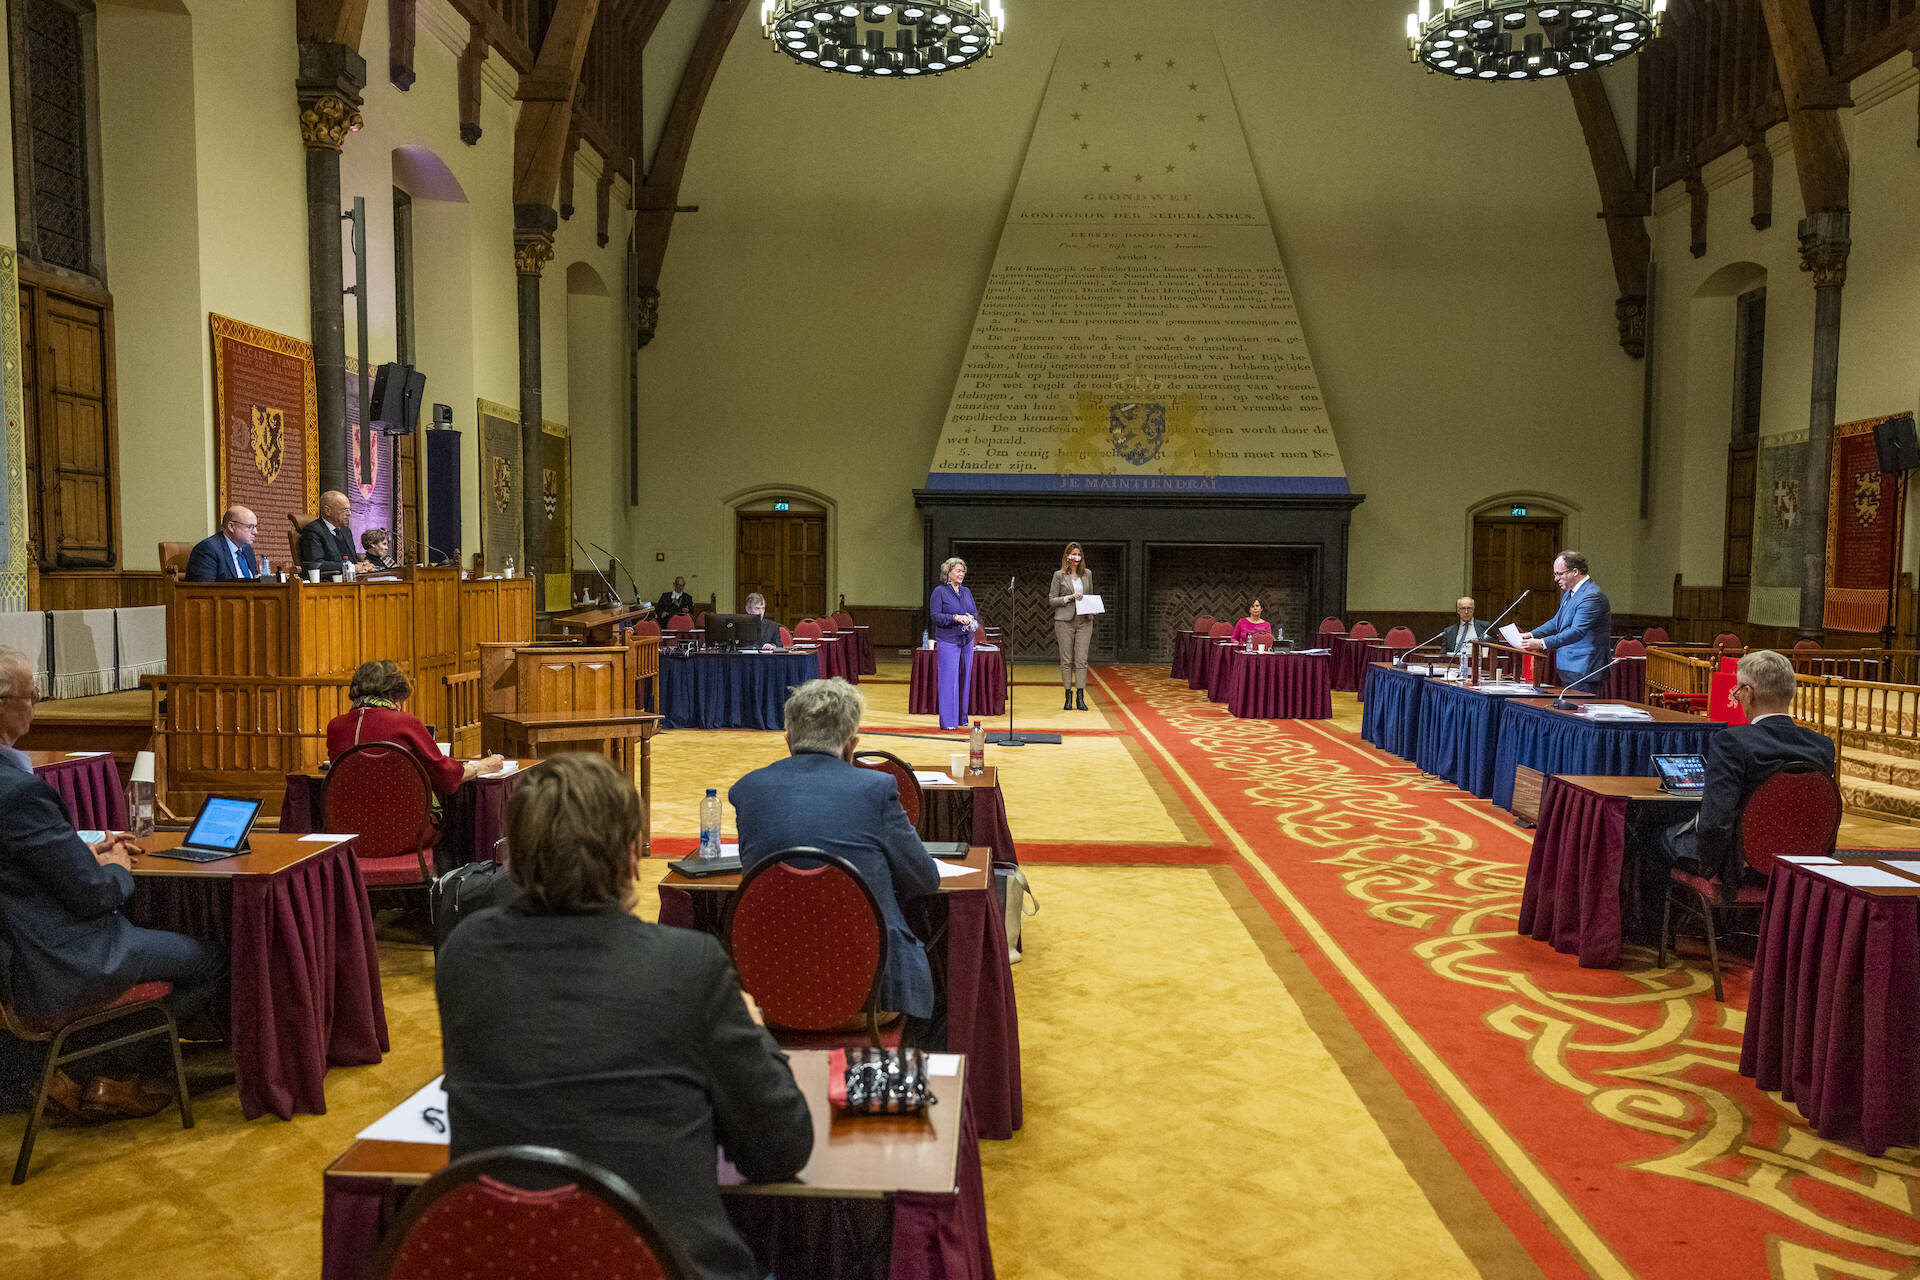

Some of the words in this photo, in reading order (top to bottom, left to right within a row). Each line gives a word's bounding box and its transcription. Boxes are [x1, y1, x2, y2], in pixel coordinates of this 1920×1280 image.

[1083, 193, 1192, 201] GRONDWET
[1032, 382, 1065, 391] regelt
[1168, 382, 1181, 390] de
[1187, 382, 1241, 392] uitzetting
[1046, 392, 1060, 400] de
[1233, 395, 1248, 403] op
[1255, 393, 1289, 401] welke
[1300, 393, 1318, 401] ten
[952, 412, 1016, 424] gendheden
[1023, 413, 1068, 421] kunnen
[965, 424, 976, 433] 4.
[991, 424, 1008, 433] De
[1240, 425, 1276, 434] wordt
[1281, 425, 1309, 434] door
[1314, 425, 1328, 434] de
[947, 436, 969, 444] wet
[974, 436, 1026, 447] bepaald.
[959, 448, 971, 457] 5.
[986, 448, 1008, 457] Om
[1016, 448, 1050, 460] eenig
[1244, 449, 1274, 458] moet
[939, 459, 1002, 470] derlander
[1061, 478, 1080, 489] JE
[1087, 478, 1217, 489] MAINTIENDRAI
